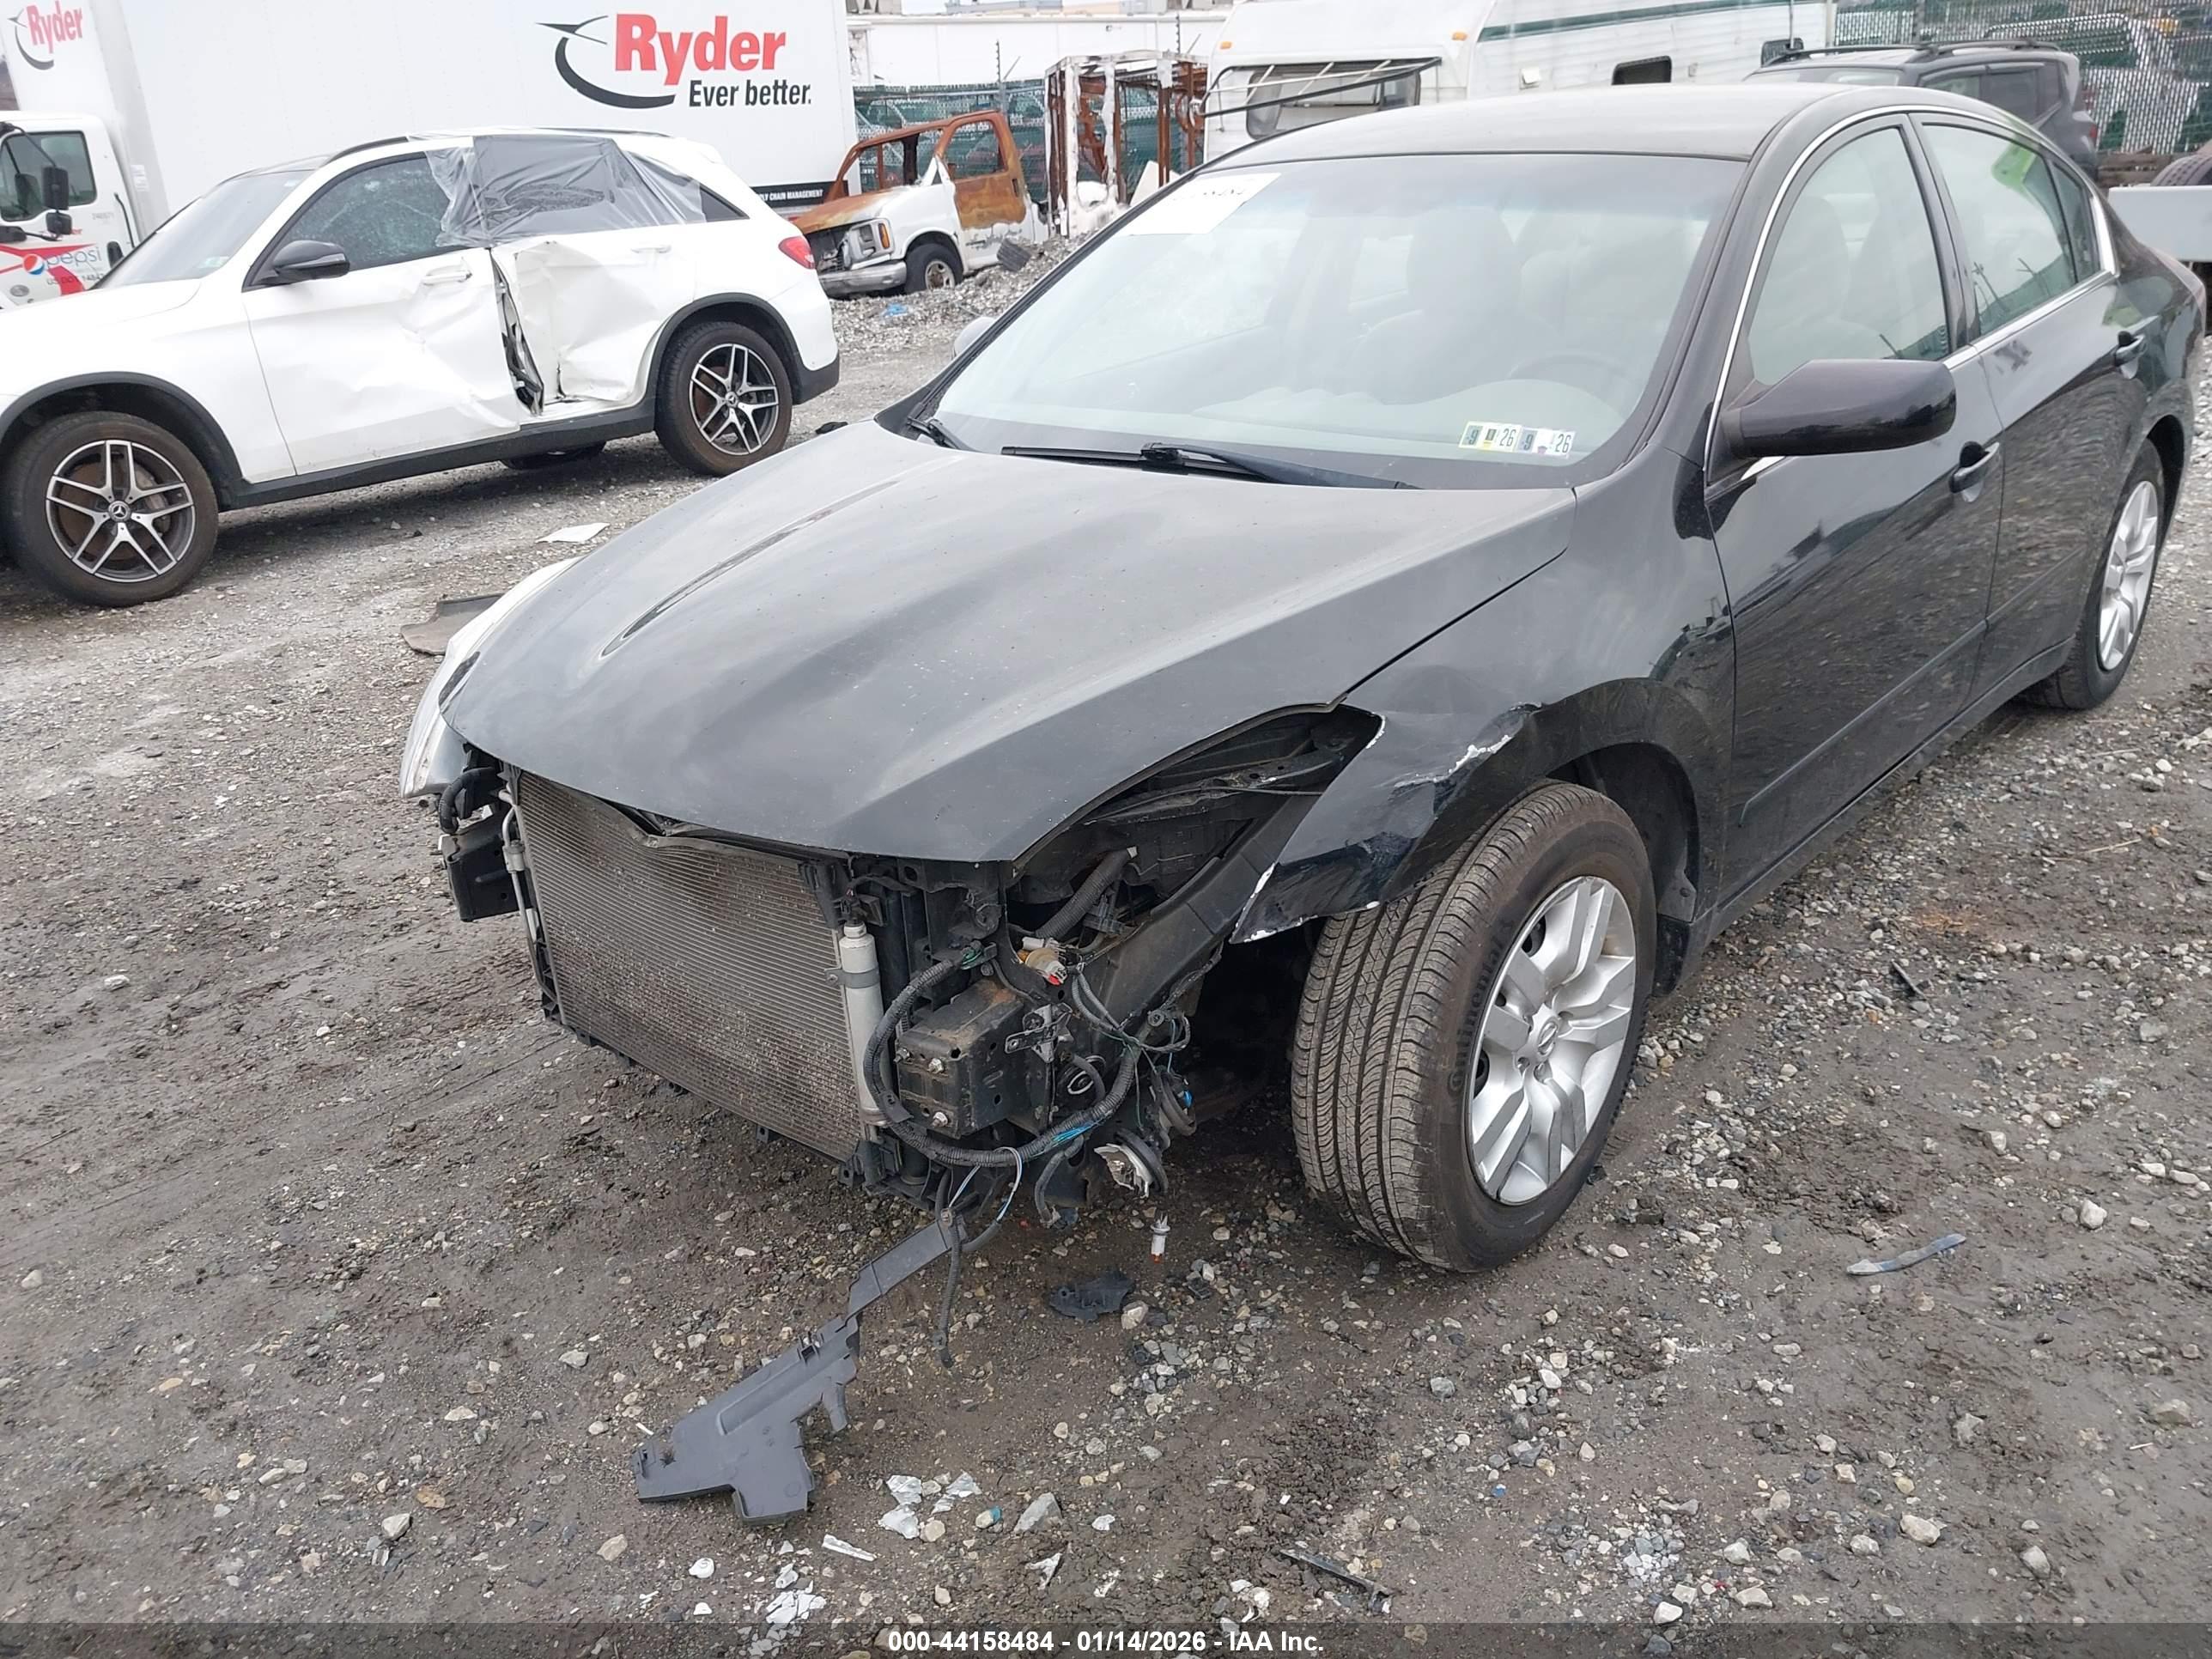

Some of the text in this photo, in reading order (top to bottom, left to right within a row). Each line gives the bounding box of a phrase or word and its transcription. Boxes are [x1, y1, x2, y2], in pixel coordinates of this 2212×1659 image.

[27, 0, 83, 54] Ryder
[615, 14, 787, 86] Ryder
[690, 79, 811, 106] Ever better.
[769, 192, 786, 202] CHAIN
[787, 189, 824, 200] MANAGEMENT
[47, 246, 102, 271] pepsi
[1499, 428, 1516, 447] 26
[1555, 433, 1572, 453] 26
